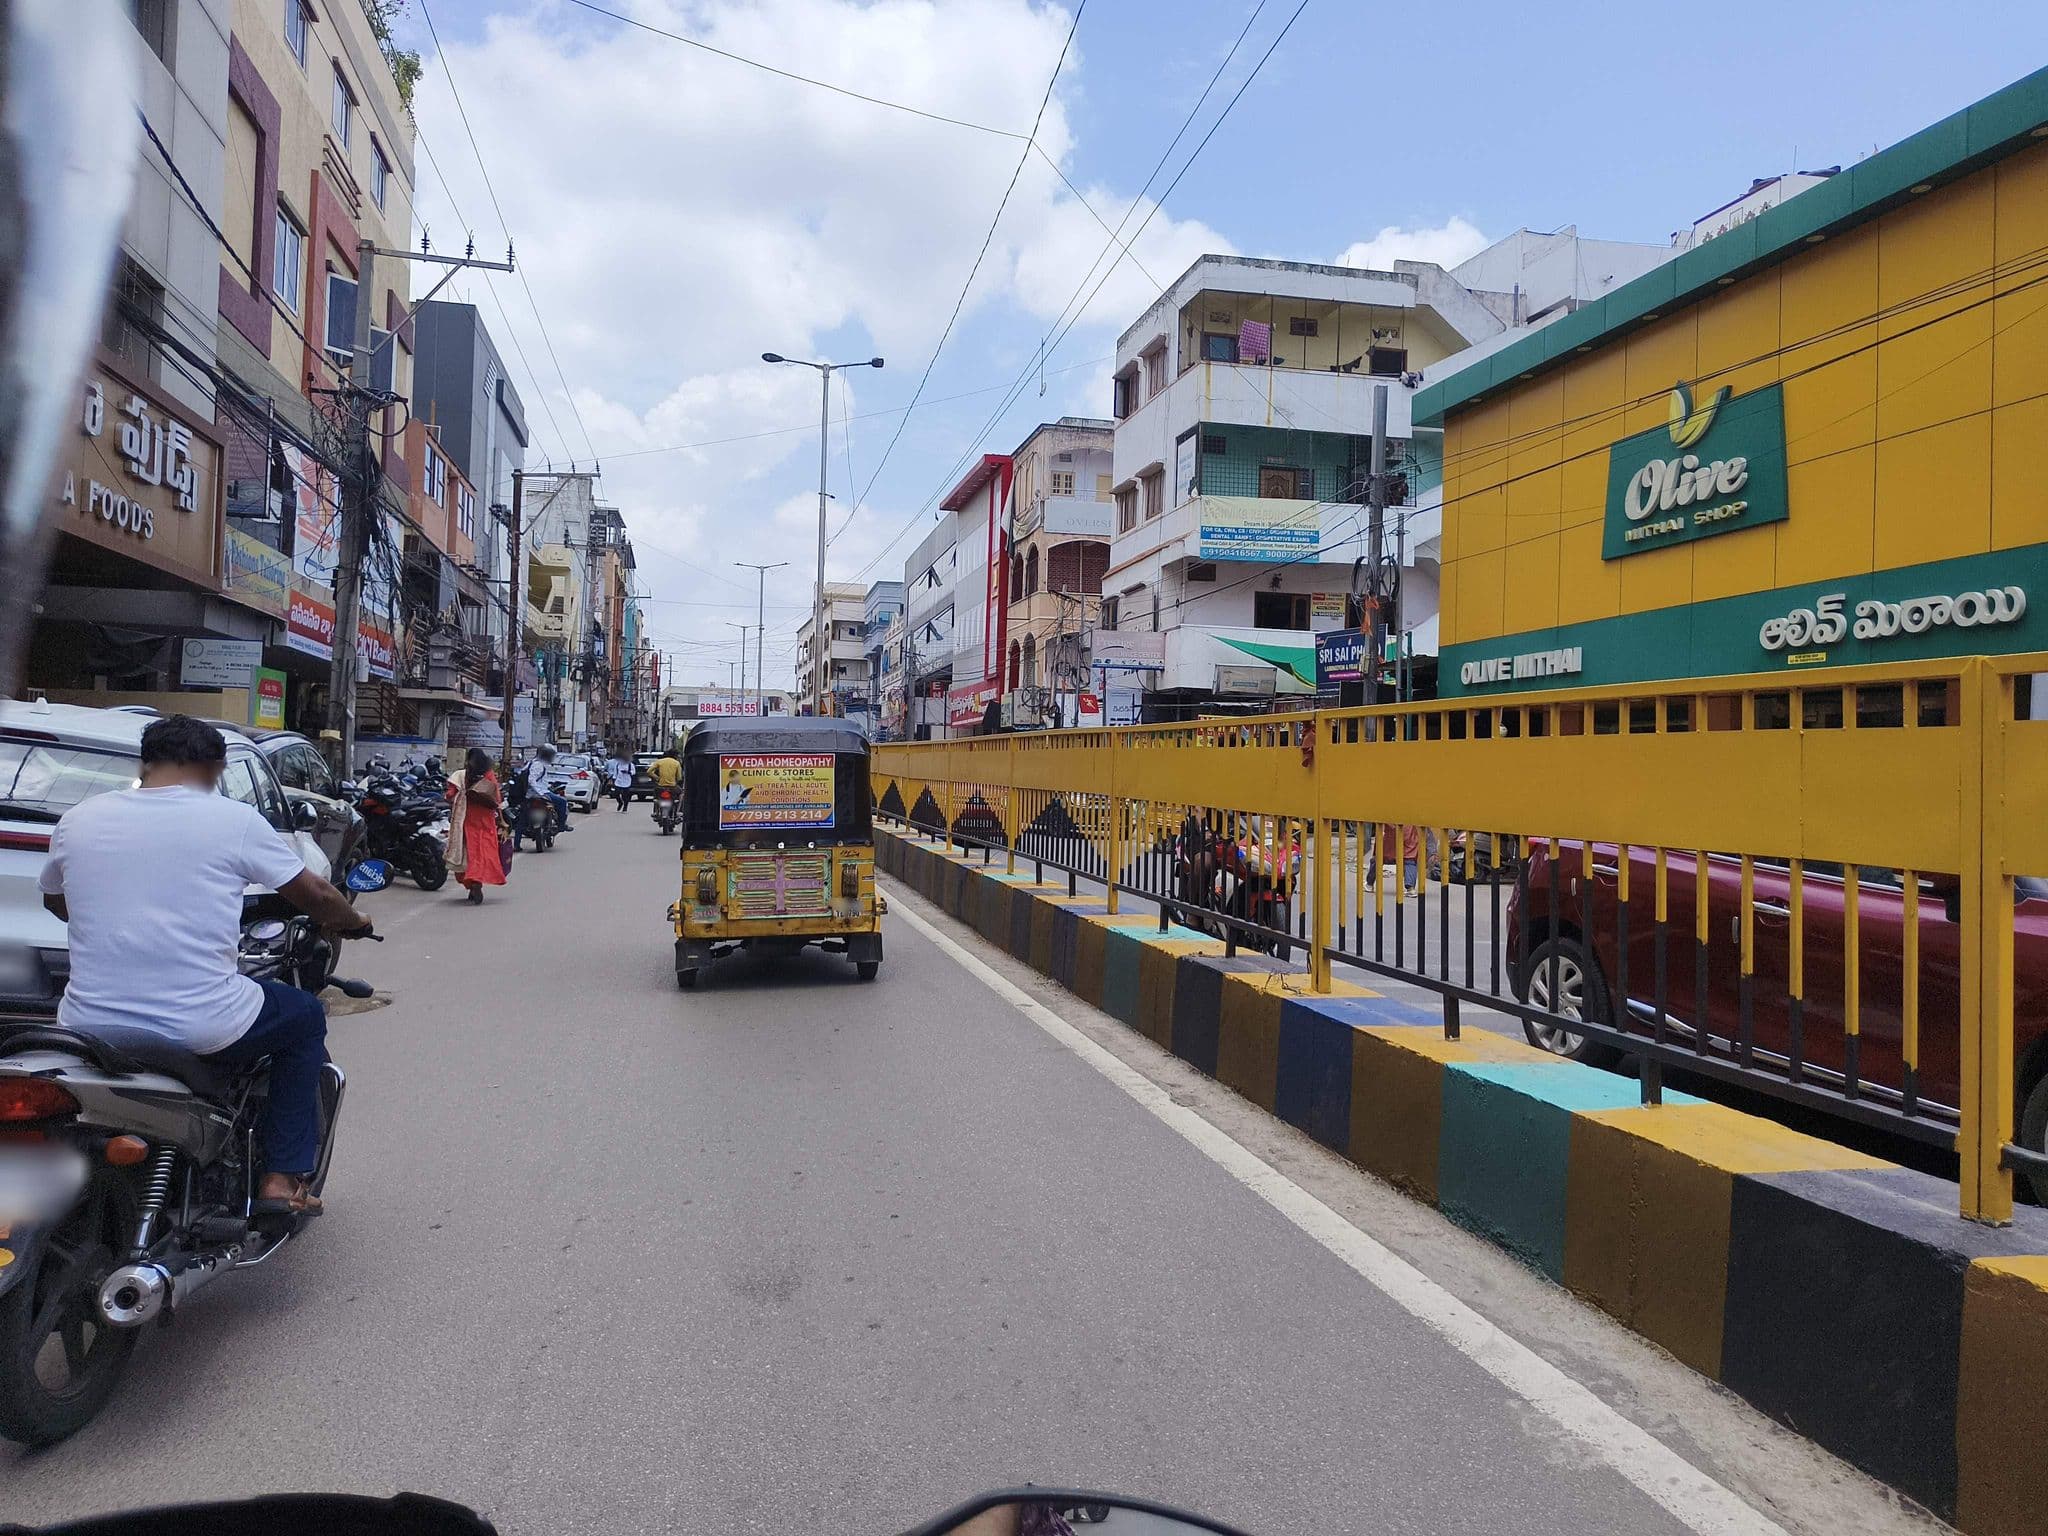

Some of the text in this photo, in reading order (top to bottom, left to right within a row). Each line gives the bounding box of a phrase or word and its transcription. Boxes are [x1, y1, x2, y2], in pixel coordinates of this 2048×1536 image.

[1624, 455, 1748, 520] Olive
[84, 478, 154, 540] FOODS
[1624, 501, 1748, 542] MITHAI SHOP
[1760, 586, 2027, 650] ఆలివ్ మిఠాయి
[1319, 647, 1333, 664] SRI
[1335, 646, 1349, 662] SAI
[1461, 647, 1583, 685] OLIVE MITHAI
[700, 703, 722, 713] 8884
[739, 757, 832, 767] VEDA HOMEOPATHY
[742, 769, 772, 777] CLINIC
[773, 769, 780, 777] &
[740, 810, 822, 820] 7799 213 214
